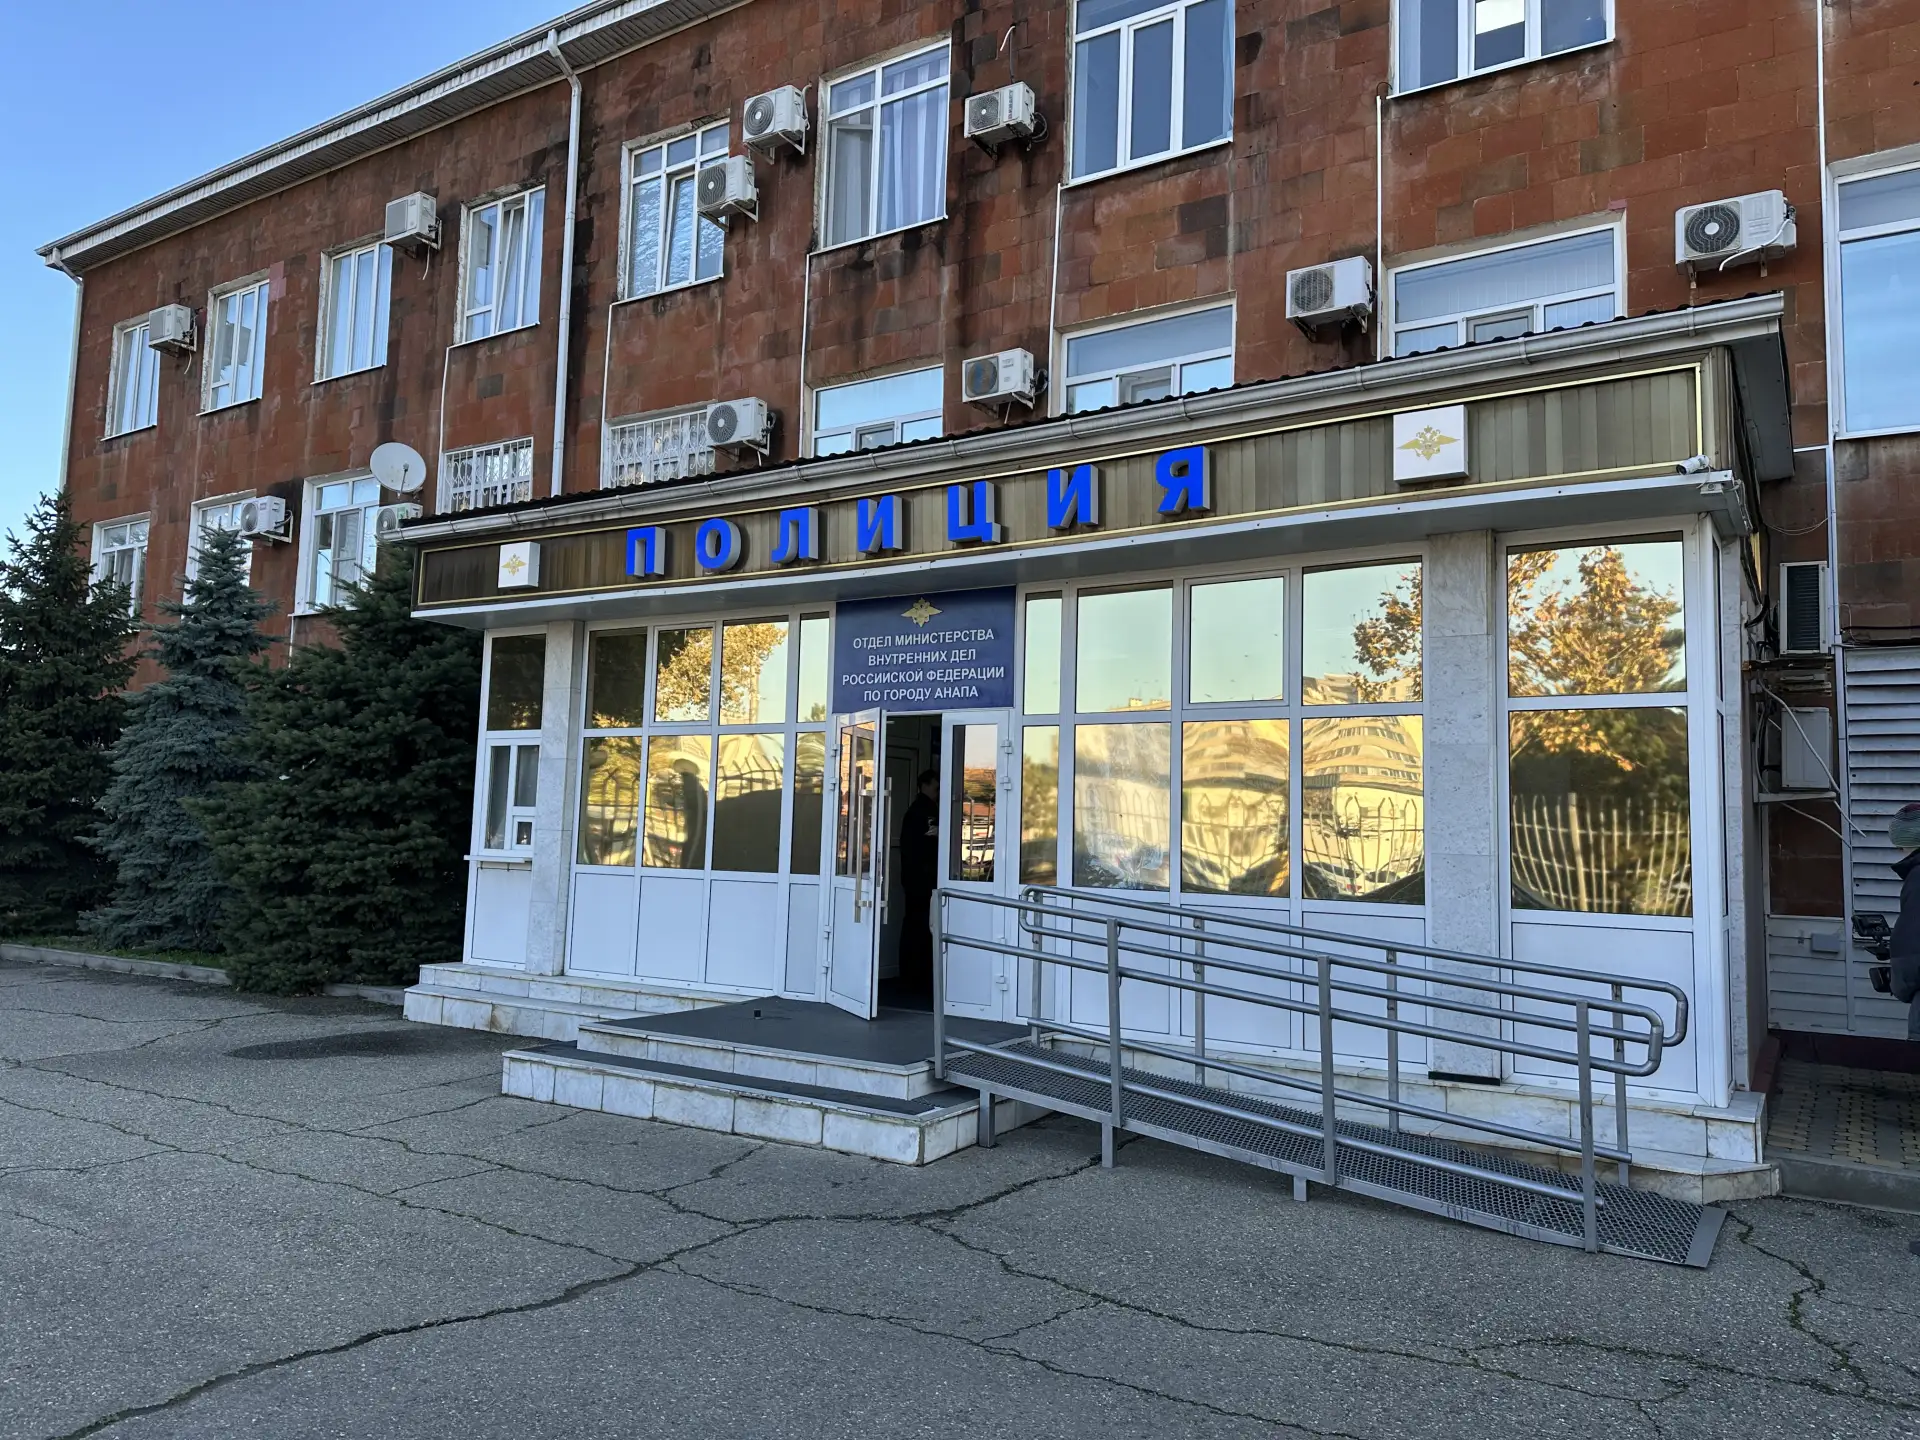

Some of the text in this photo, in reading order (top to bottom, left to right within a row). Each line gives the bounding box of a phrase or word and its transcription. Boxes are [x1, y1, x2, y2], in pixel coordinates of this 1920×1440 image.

[625, 445, 1211, 577] ПОЛИЦИЯ
[853, 628, 995, 650] ОТДЕЛ МИНИСТЕРСТВА
[868, 648, 976, 666] ВНУТРЕННИХ ДЕЛ
[926, 666, 1004, 682] ФЕДЕРАЦИИ
[864, 685, 979, 702] ПО ГОРОДУ АНАПА
